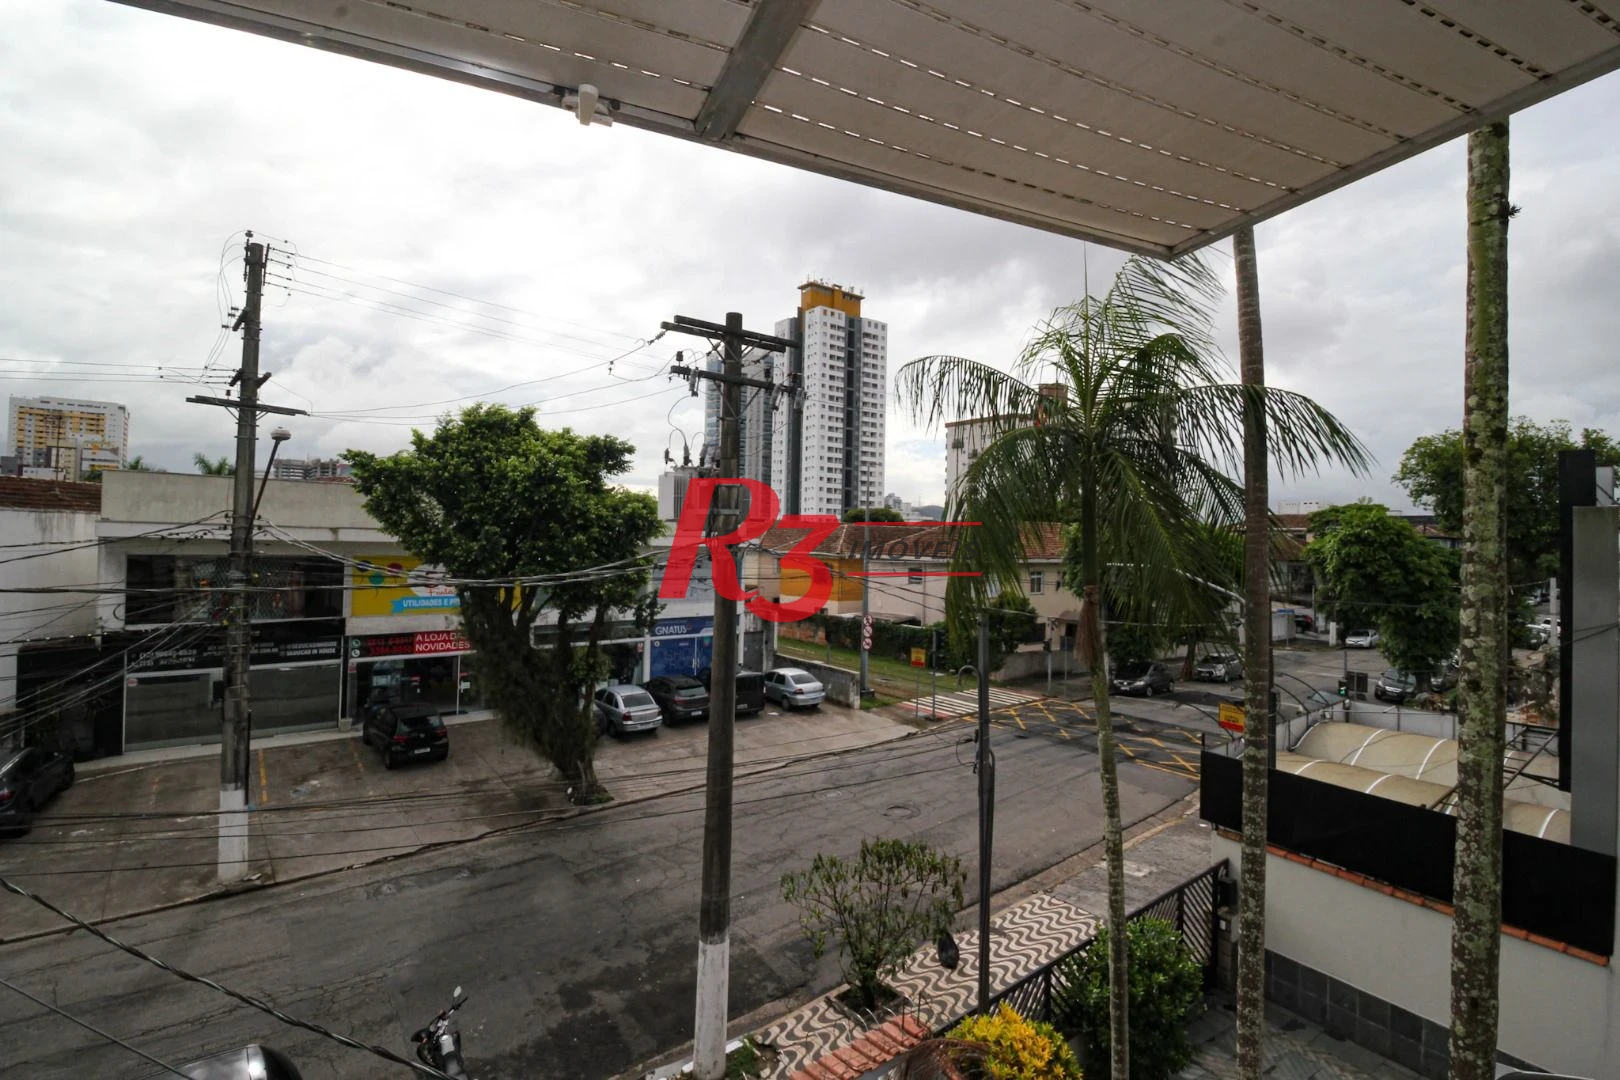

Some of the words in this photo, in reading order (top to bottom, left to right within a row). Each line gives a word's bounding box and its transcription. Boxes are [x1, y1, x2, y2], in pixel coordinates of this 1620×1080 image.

[403, 598, 442, 607] UTILIDADES
[655, 625, 687, 635] GNATUS
[416, 633, 423, 642] A
[424, 633, 449, 642] LOJA
[415, 641, 470, 652] NOVIDADES
